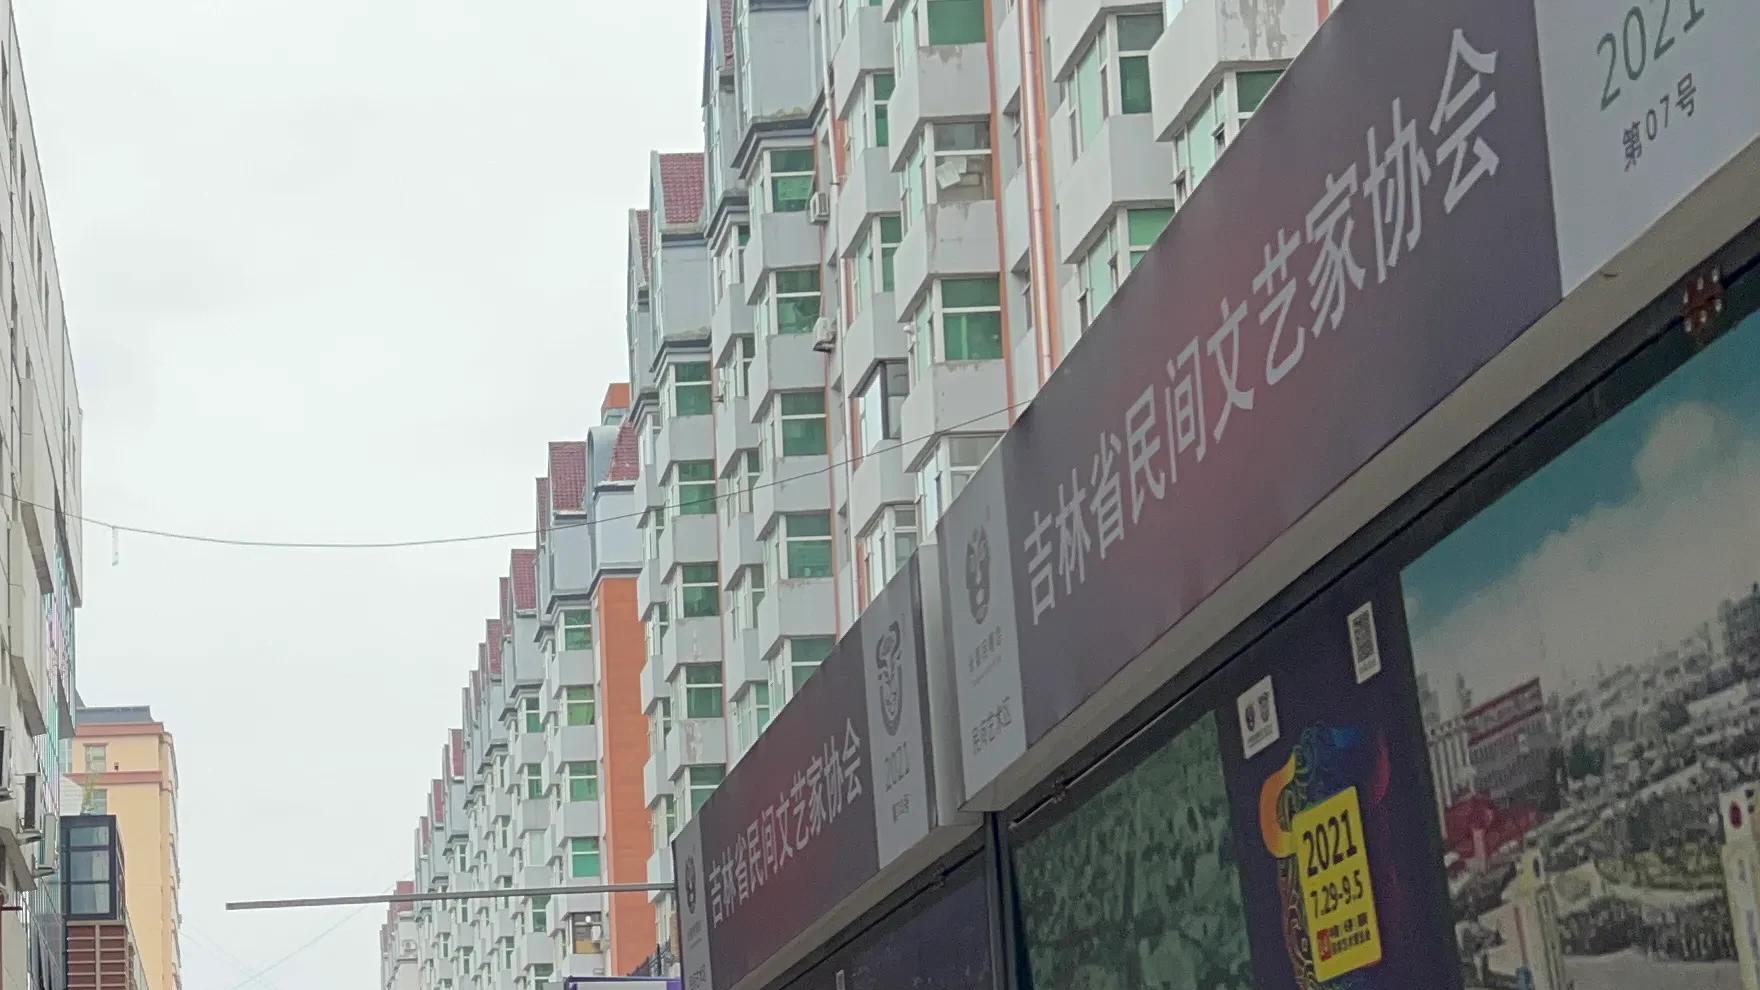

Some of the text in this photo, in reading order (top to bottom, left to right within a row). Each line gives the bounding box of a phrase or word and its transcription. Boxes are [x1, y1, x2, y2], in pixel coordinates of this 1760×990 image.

[1623, 73, 1696, 172] 第07号
[1023, 28, 1501, 626] 吉林省民间文艺家协会
[709, 717, 862, 928] 吉林省民间文艺家协会
[1303, 809, 1357, 877] 2021
